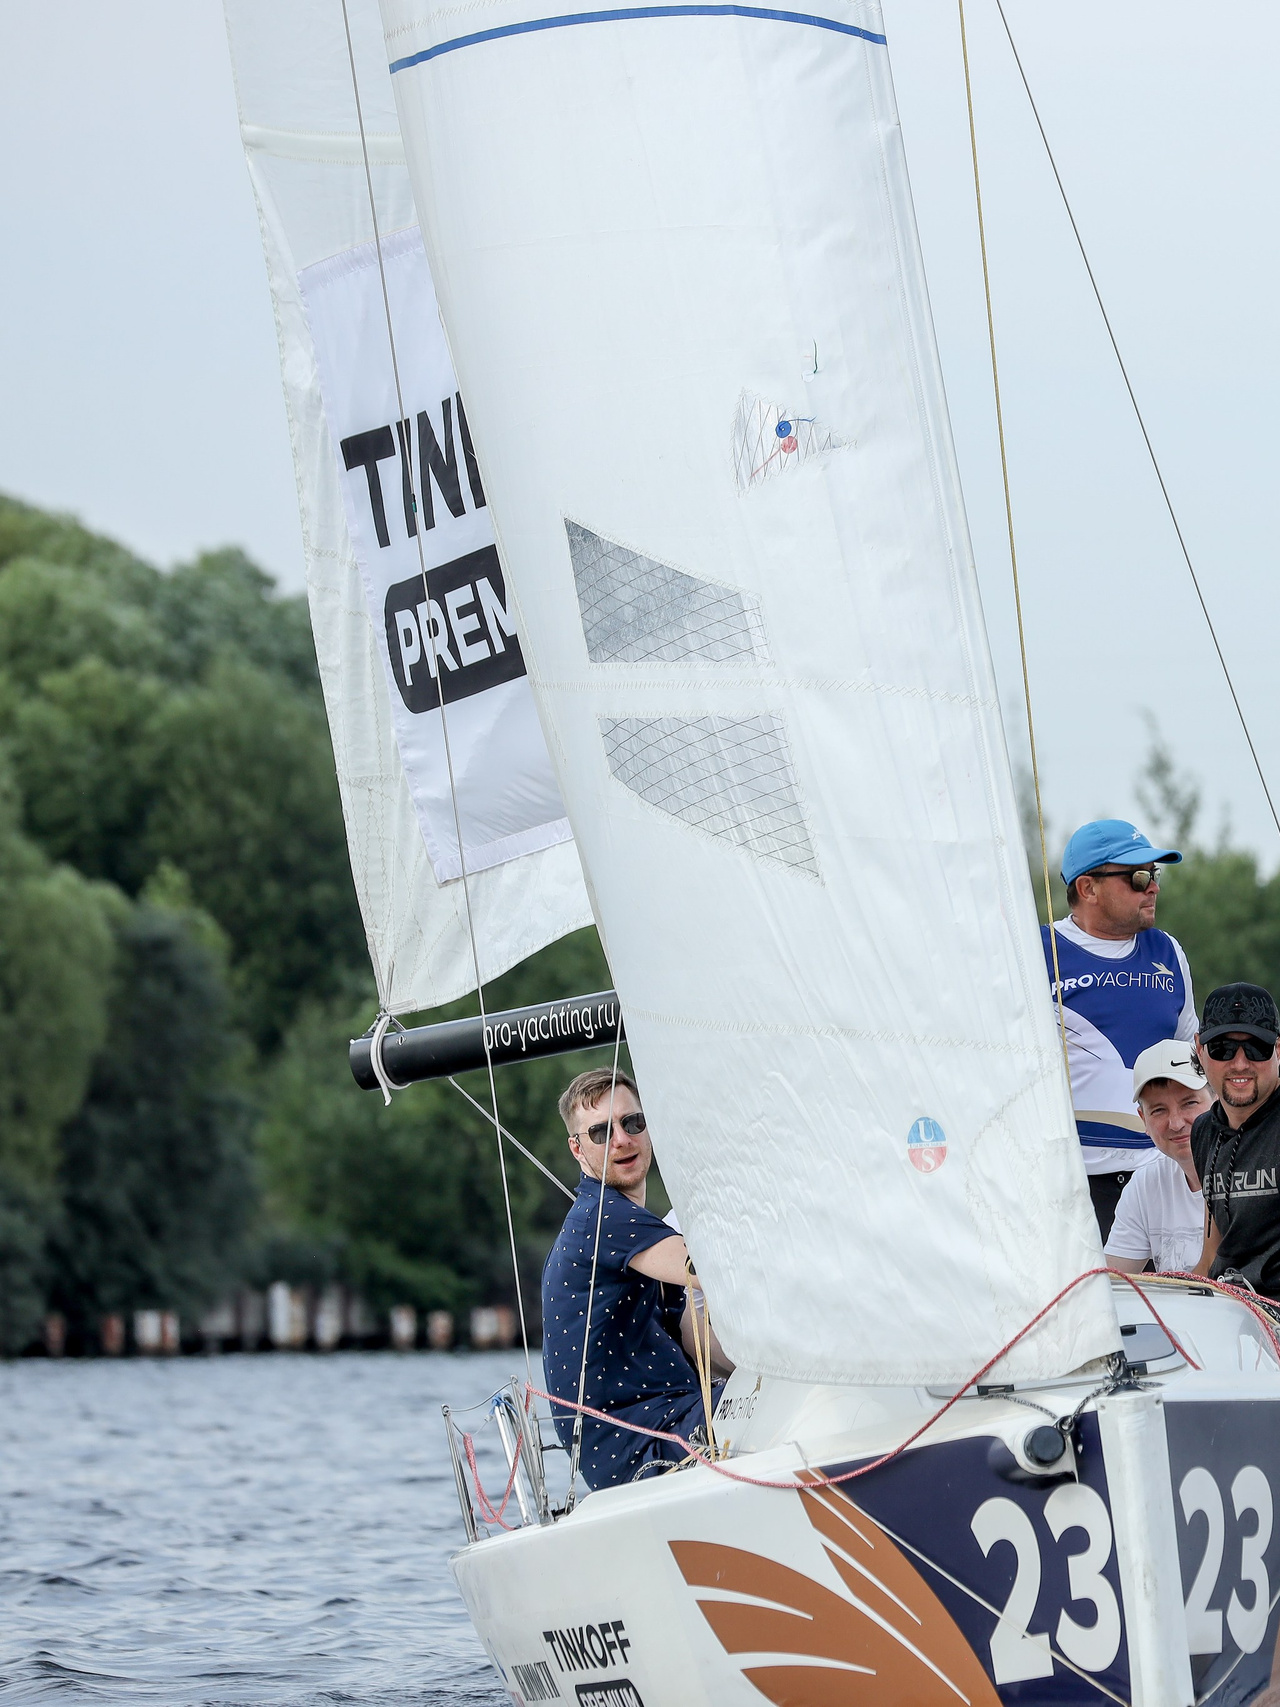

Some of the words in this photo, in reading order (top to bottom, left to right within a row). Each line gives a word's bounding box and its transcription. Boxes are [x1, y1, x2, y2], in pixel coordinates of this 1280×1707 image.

[484, 1002, 616, 1051] pro-yachting.ru
[970, 1482, 1122, 1686] 23
[1178, 1465, 1275, 1656] 23
[542, 1619, 632, 1673] TINKOFF
